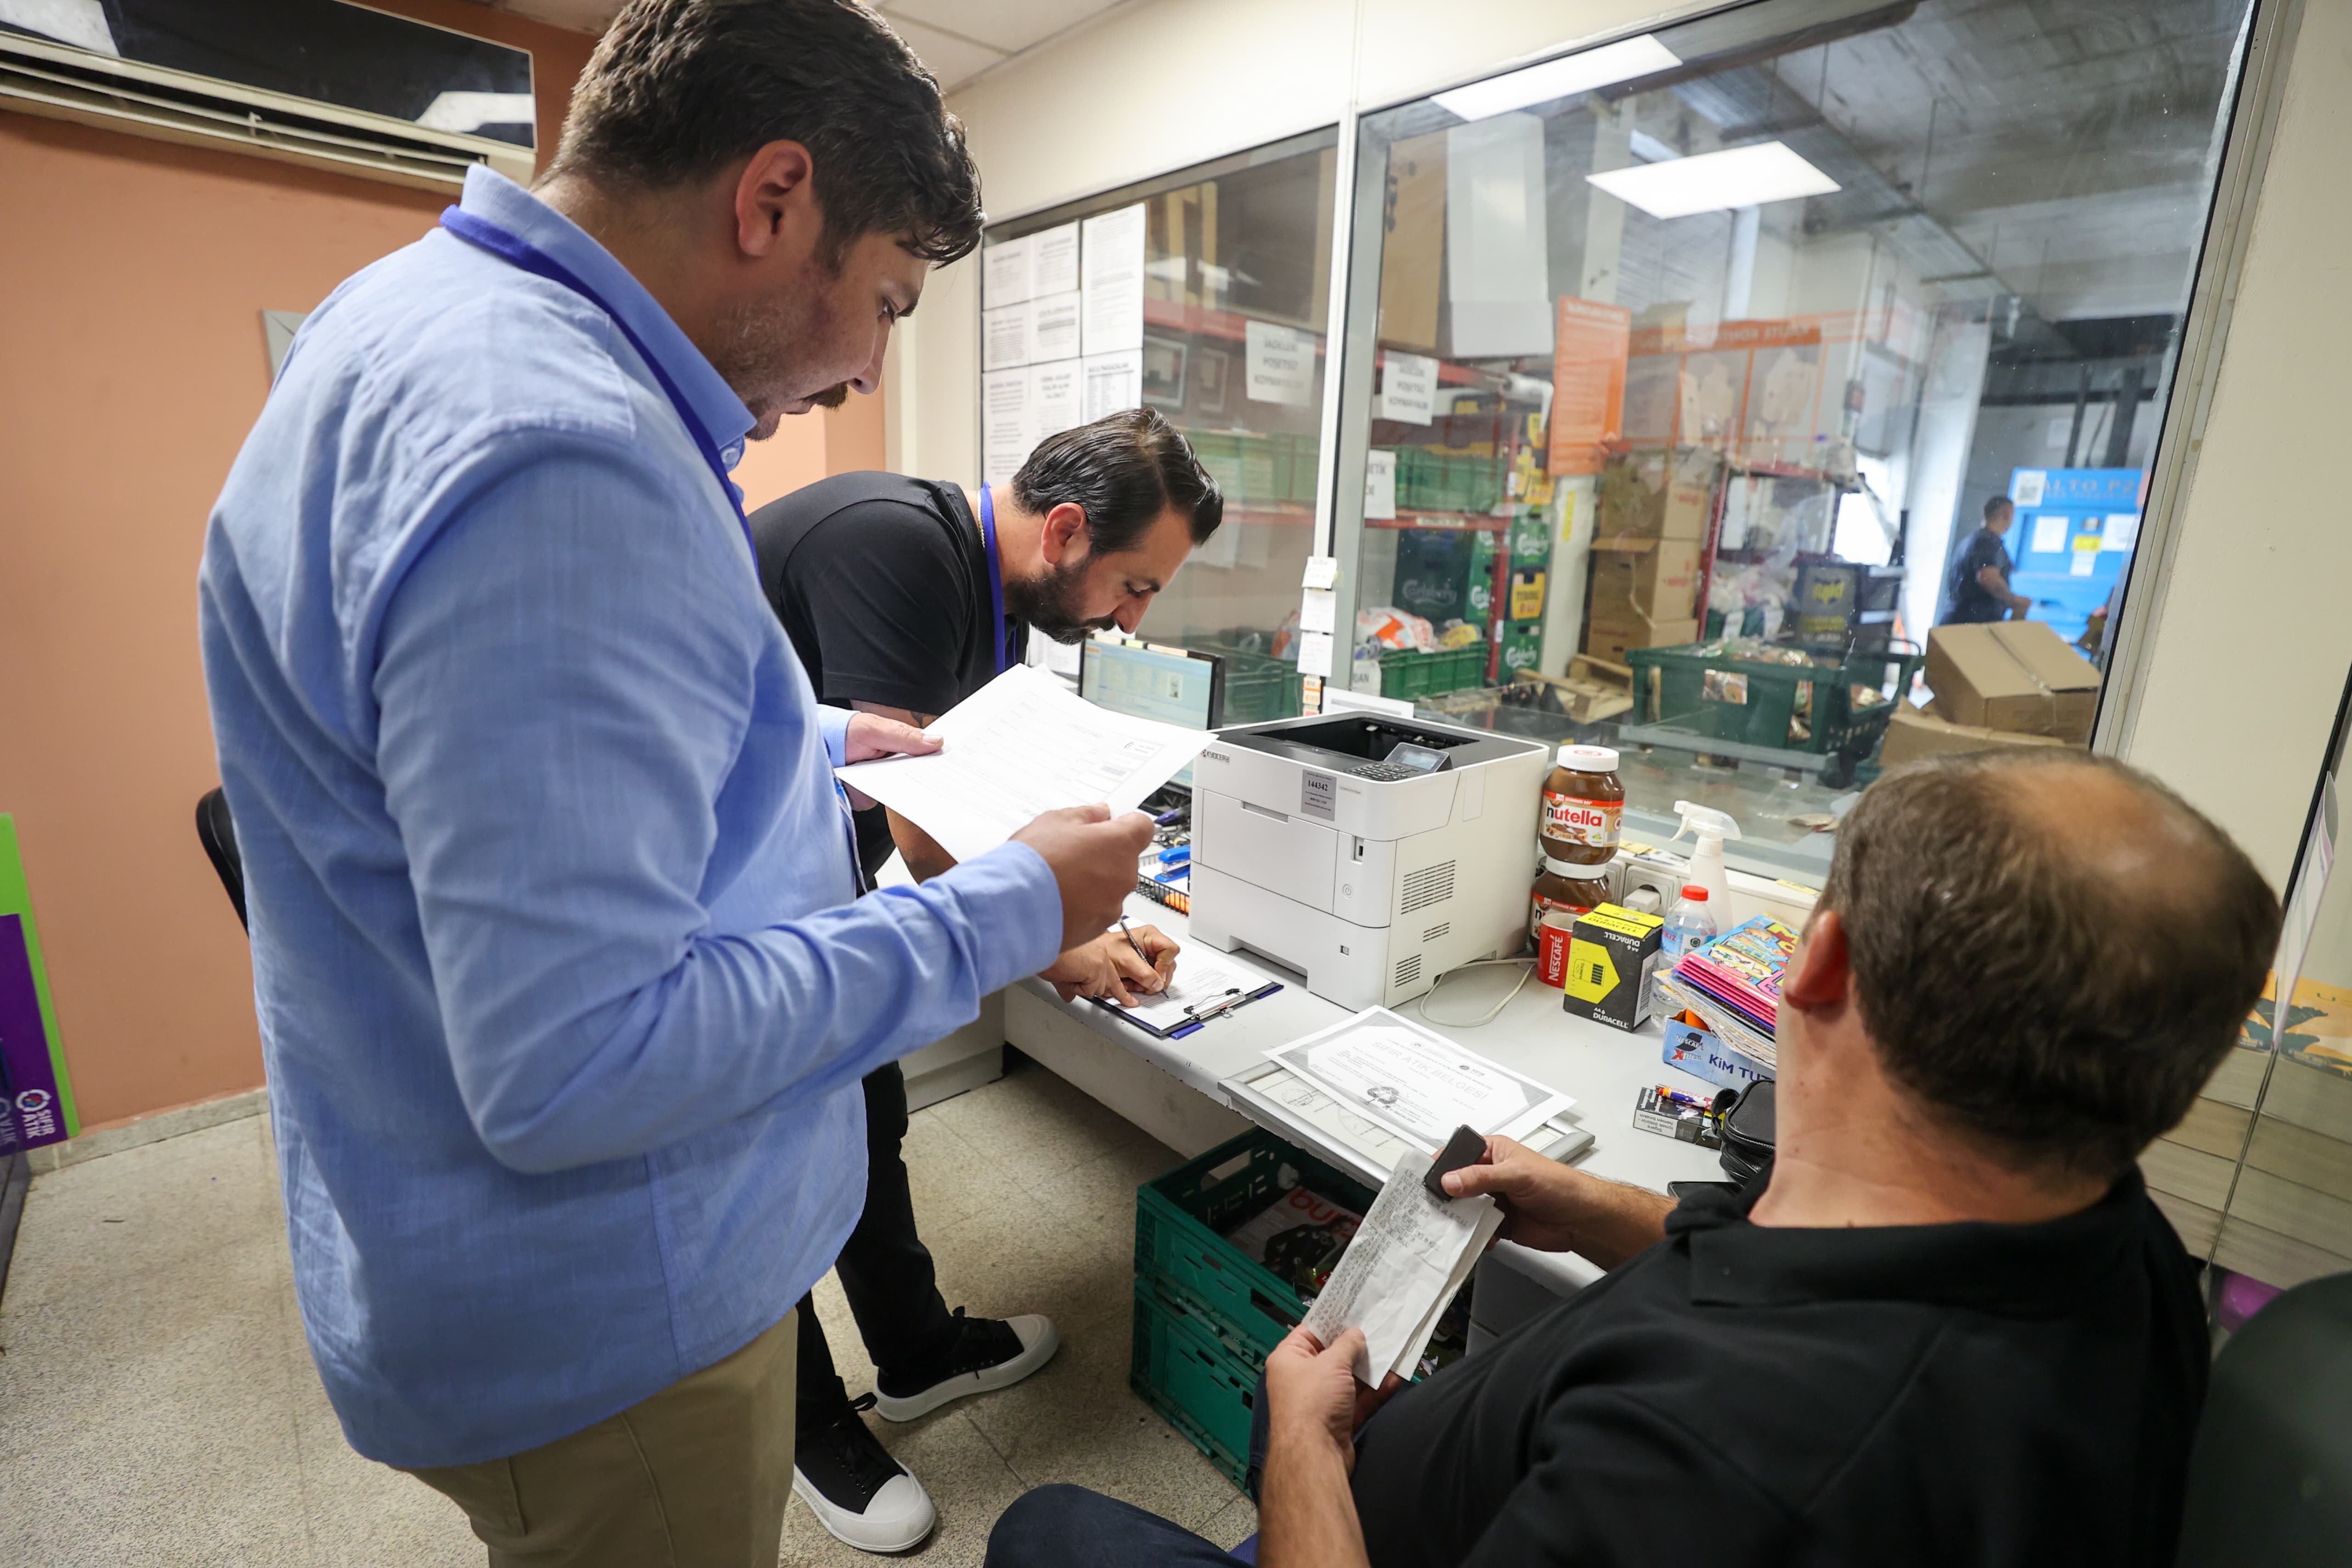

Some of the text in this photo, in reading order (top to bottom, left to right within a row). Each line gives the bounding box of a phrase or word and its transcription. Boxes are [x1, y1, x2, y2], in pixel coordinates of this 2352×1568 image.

[1308, 780, 1328, 791] 144342
[1547, 806, 1602, 826] nutella
[1588, 918, 1638, 933] DURACELL
[1604, 931, 1640, 947] DURACELL
[1593, 1012, 1628, 1029] DURACELL
[1372, 1042, 1489, 1100] SIFIR ATIK BELGESİ
[22, 1113, 41, 1139] ATIK
[37, 1109, 56, 1135] SIFIR
